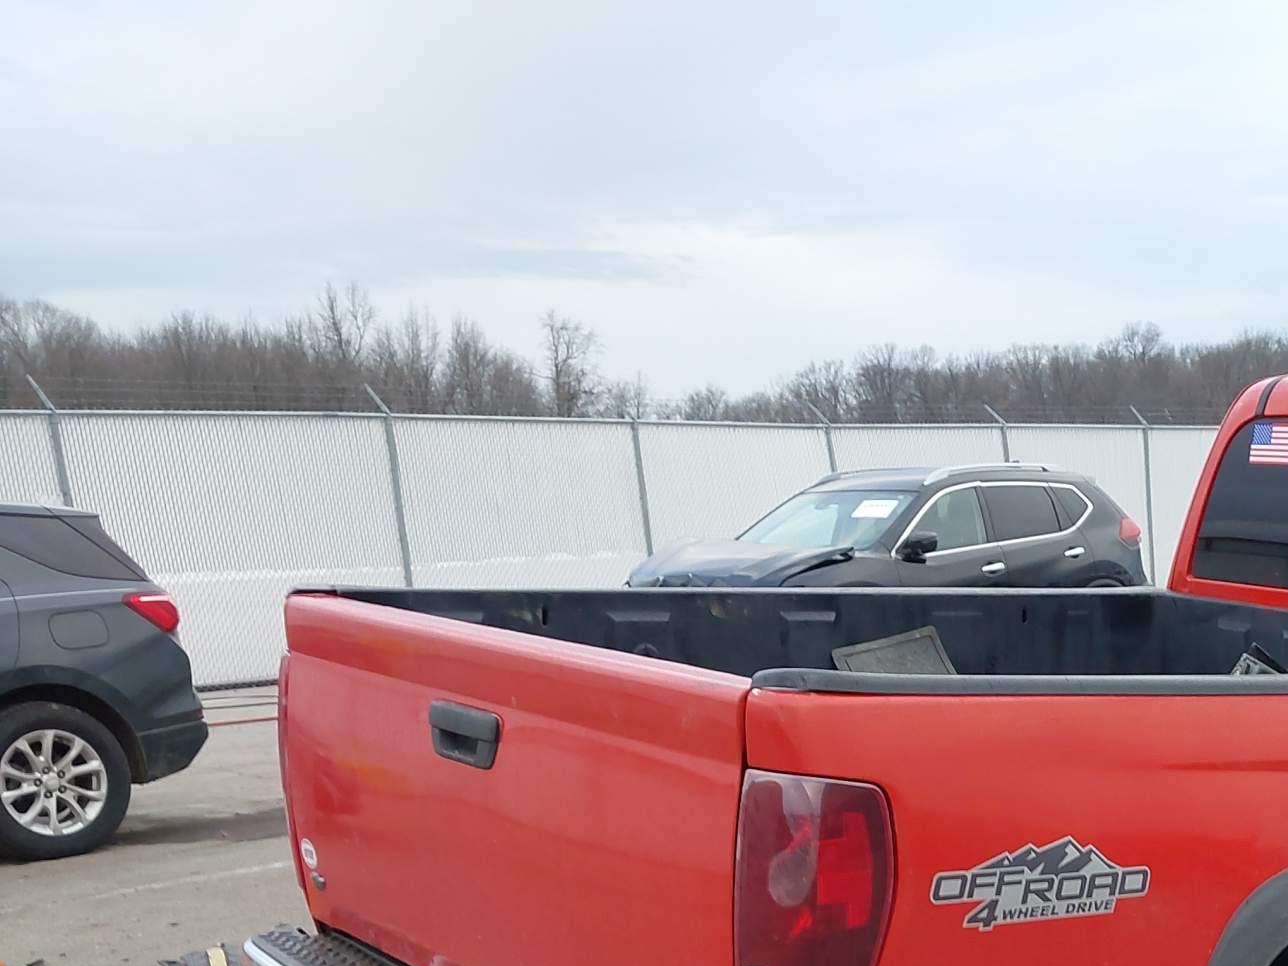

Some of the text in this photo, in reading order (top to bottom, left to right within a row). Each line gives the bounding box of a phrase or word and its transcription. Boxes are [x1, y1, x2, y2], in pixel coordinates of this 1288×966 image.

[966, 898, 1115, 928] 4 WHEEL DRIVE
